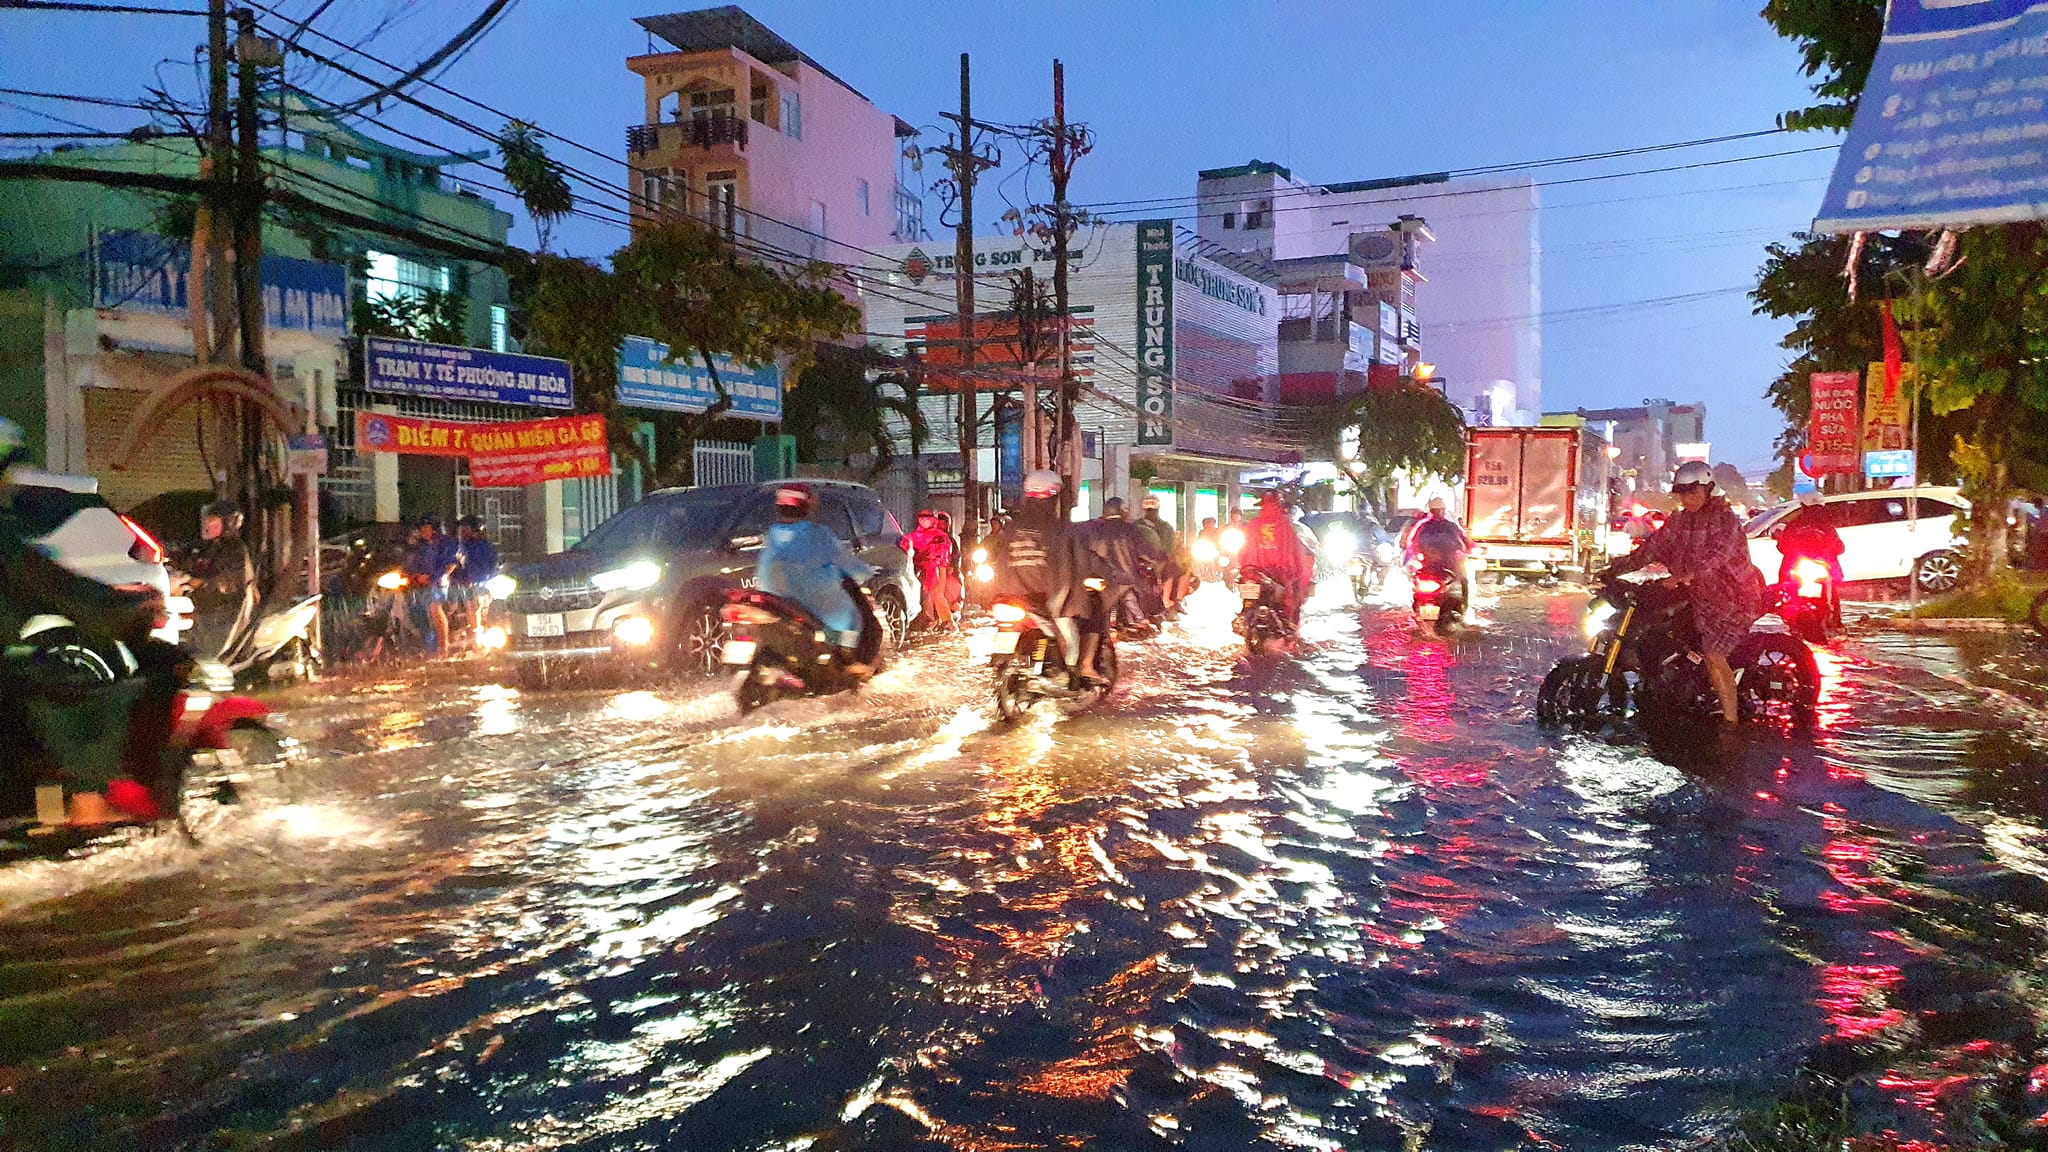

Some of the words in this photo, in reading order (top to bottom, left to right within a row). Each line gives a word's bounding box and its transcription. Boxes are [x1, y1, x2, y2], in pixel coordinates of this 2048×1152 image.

[934, 253, 987, 270] TRG
[1144, 263, 1166, 368] TRUNG
[423, 362, 433, 381] Y
[436, 358, 456, 381] TẾ
[518, 373, 537, 391] AN
